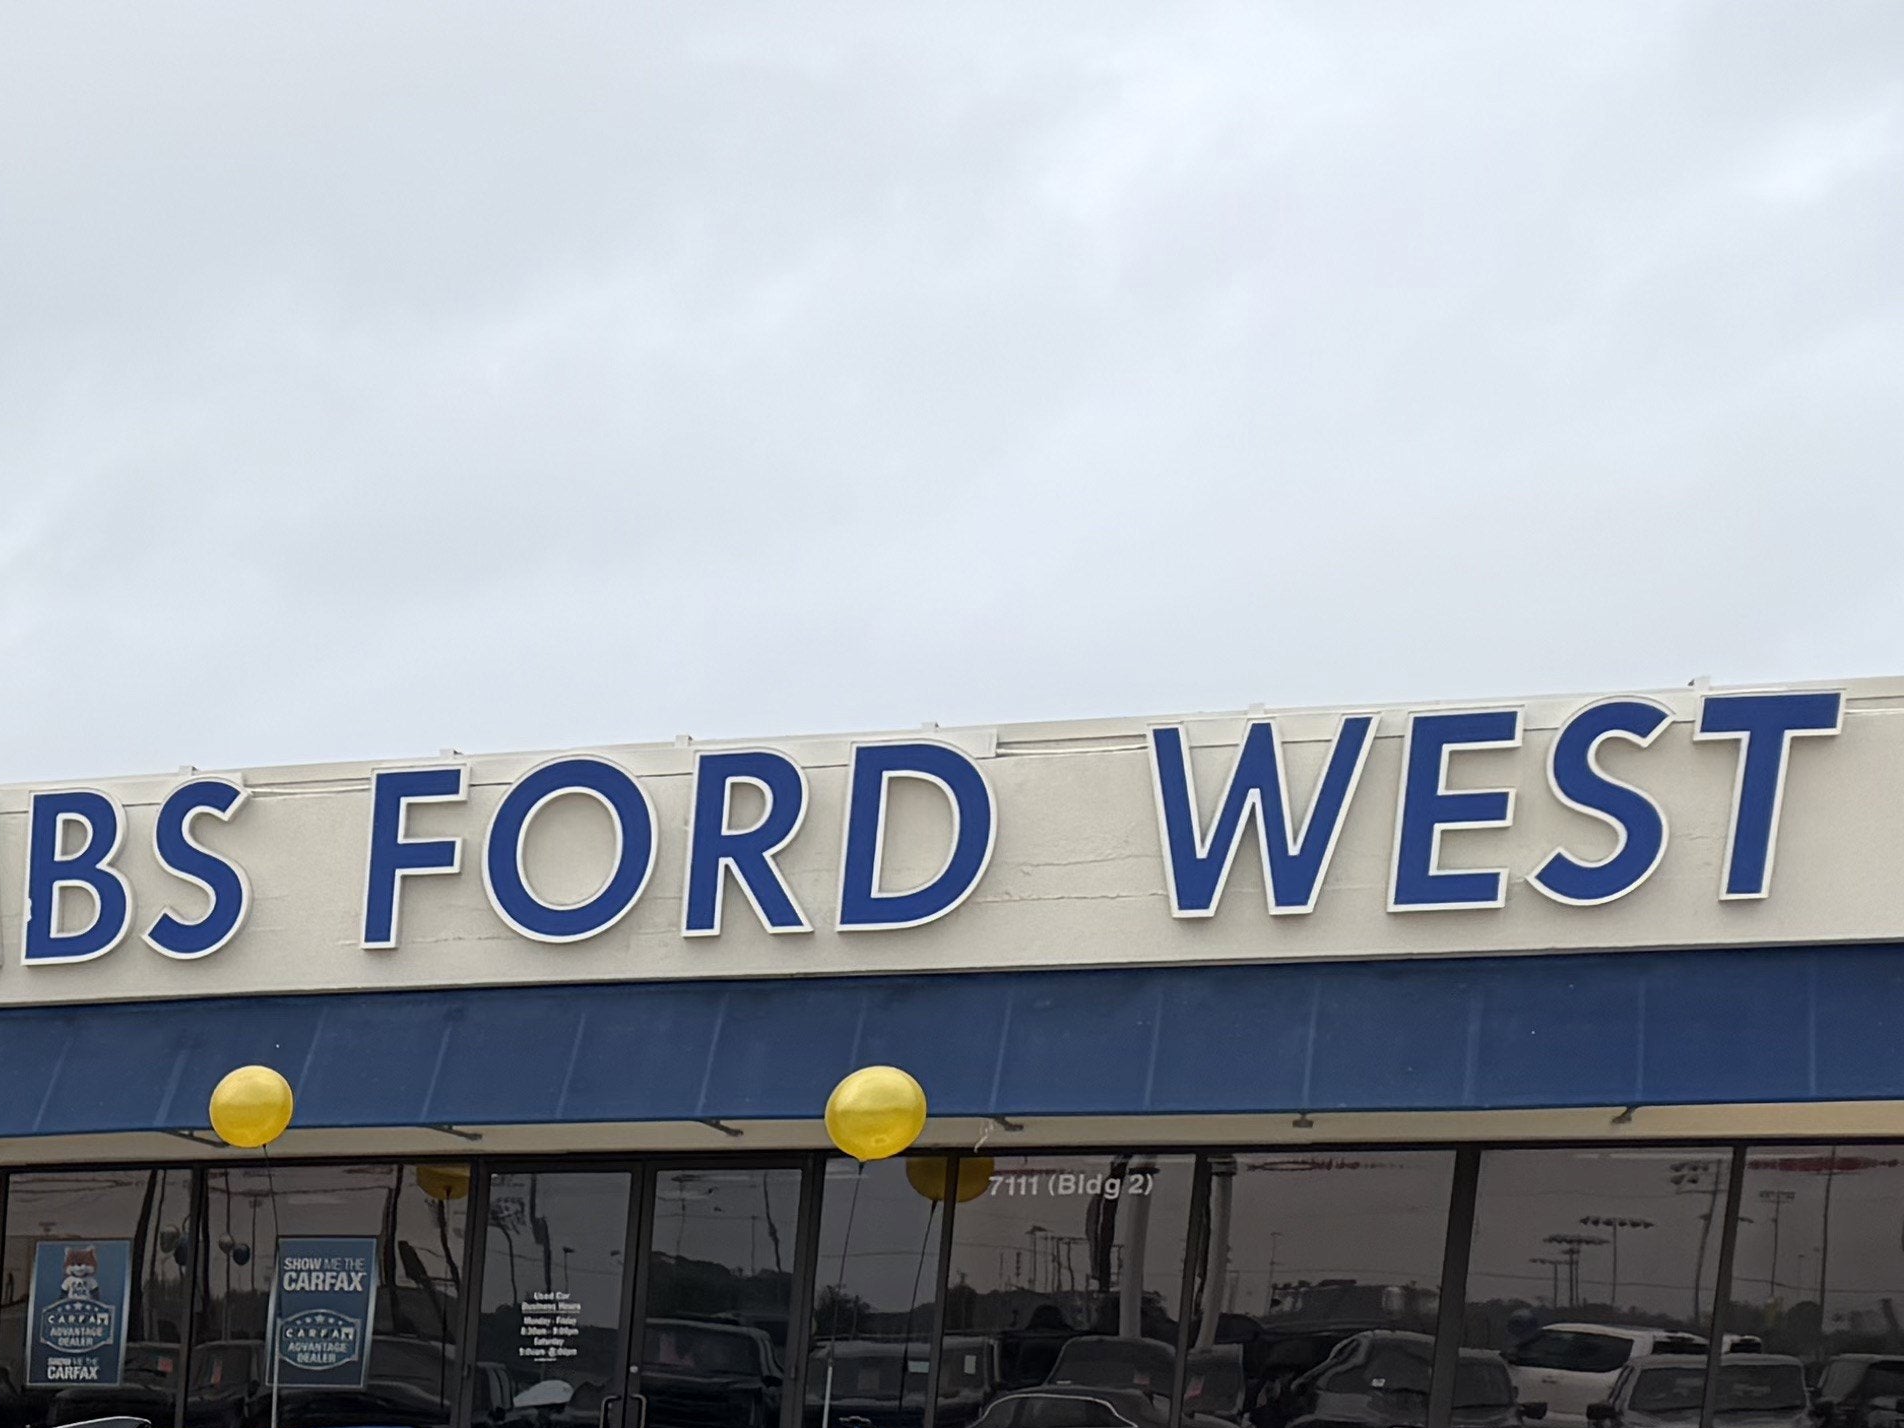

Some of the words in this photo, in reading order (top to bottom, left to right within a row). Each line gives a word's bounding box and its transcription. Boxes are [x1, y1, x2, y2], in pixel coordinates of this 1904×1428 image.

[360, 740, 997, 950] FORD
[1146, 690, 1847, 918] WEST
[988, 1174, 1039, 1196] 7111
[1048, 1173, 1121, 1199] (Bldg
[1128, 1173, 1154, 1196] 2)
[284, 1257, 322, 1271] SHOW
[323, 1258, 342, 1271] ME
[344, 1257, 366, 1271] THE
[283, 1271, 364, 1292] CARFAX
[47, 1366, 100, 1380] CARFAX
